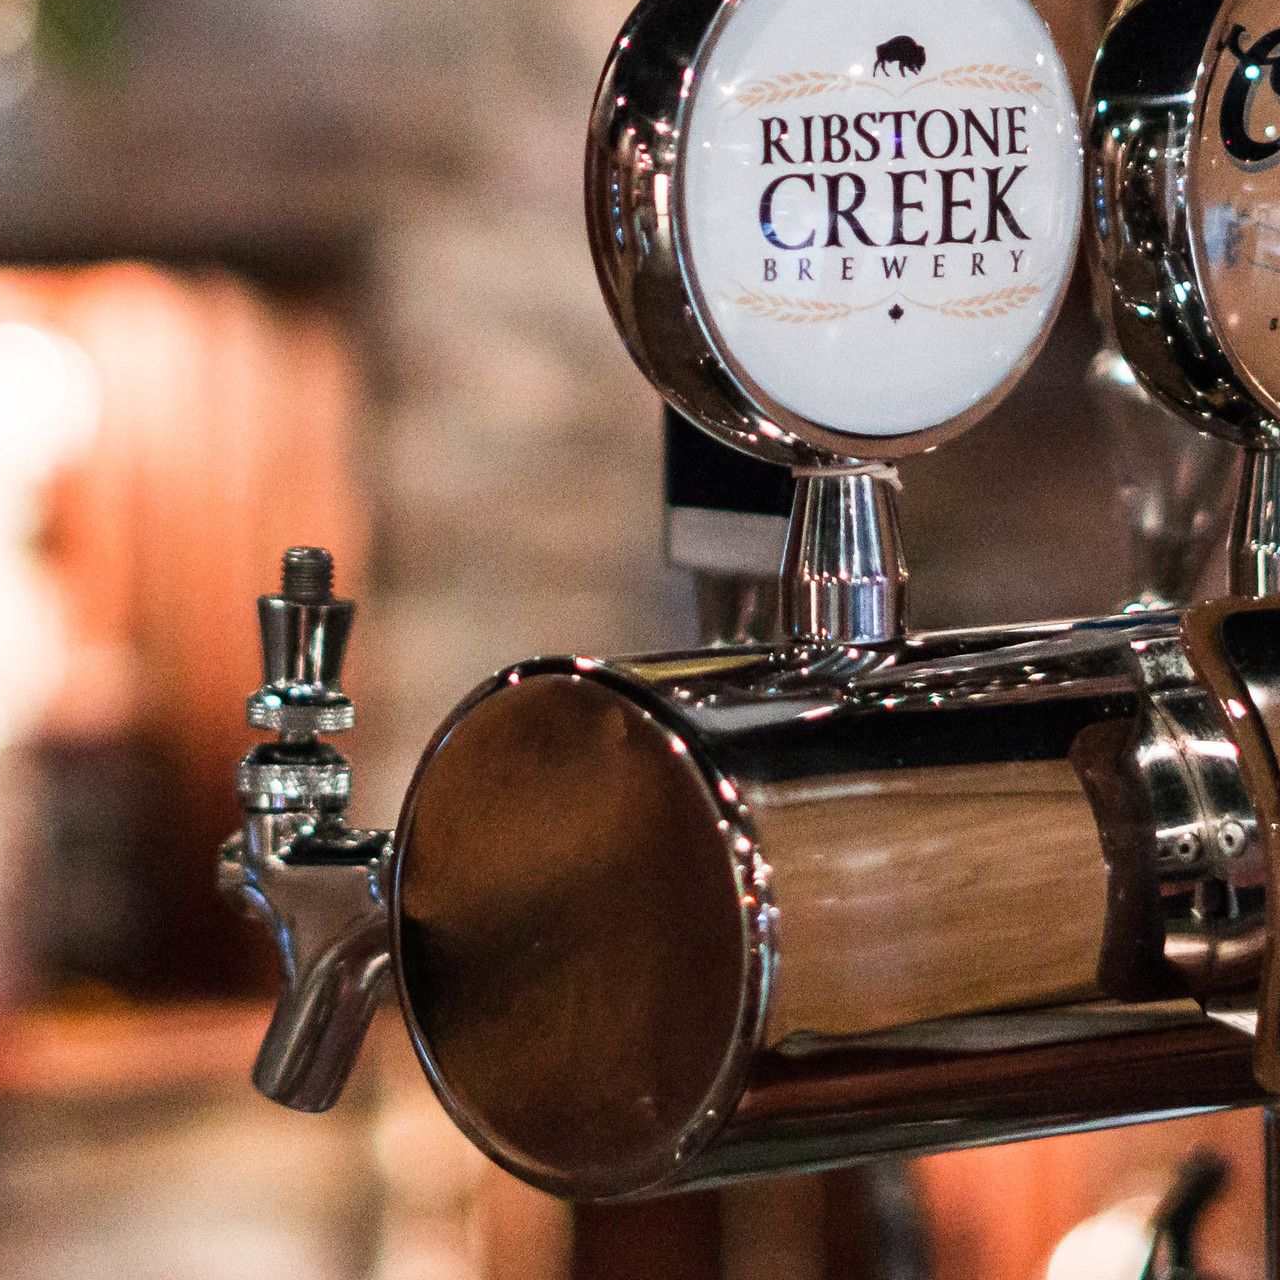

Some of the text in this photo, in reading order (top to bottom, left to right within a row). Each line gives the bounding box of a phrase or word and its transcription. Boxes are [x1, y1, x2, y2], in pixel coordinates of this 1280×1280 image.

[759, 106, 1029, 166] RIBSTONE
[759, 164, 1032, 251] CREEK
[763, 248, 1025, 282] BREWERY
